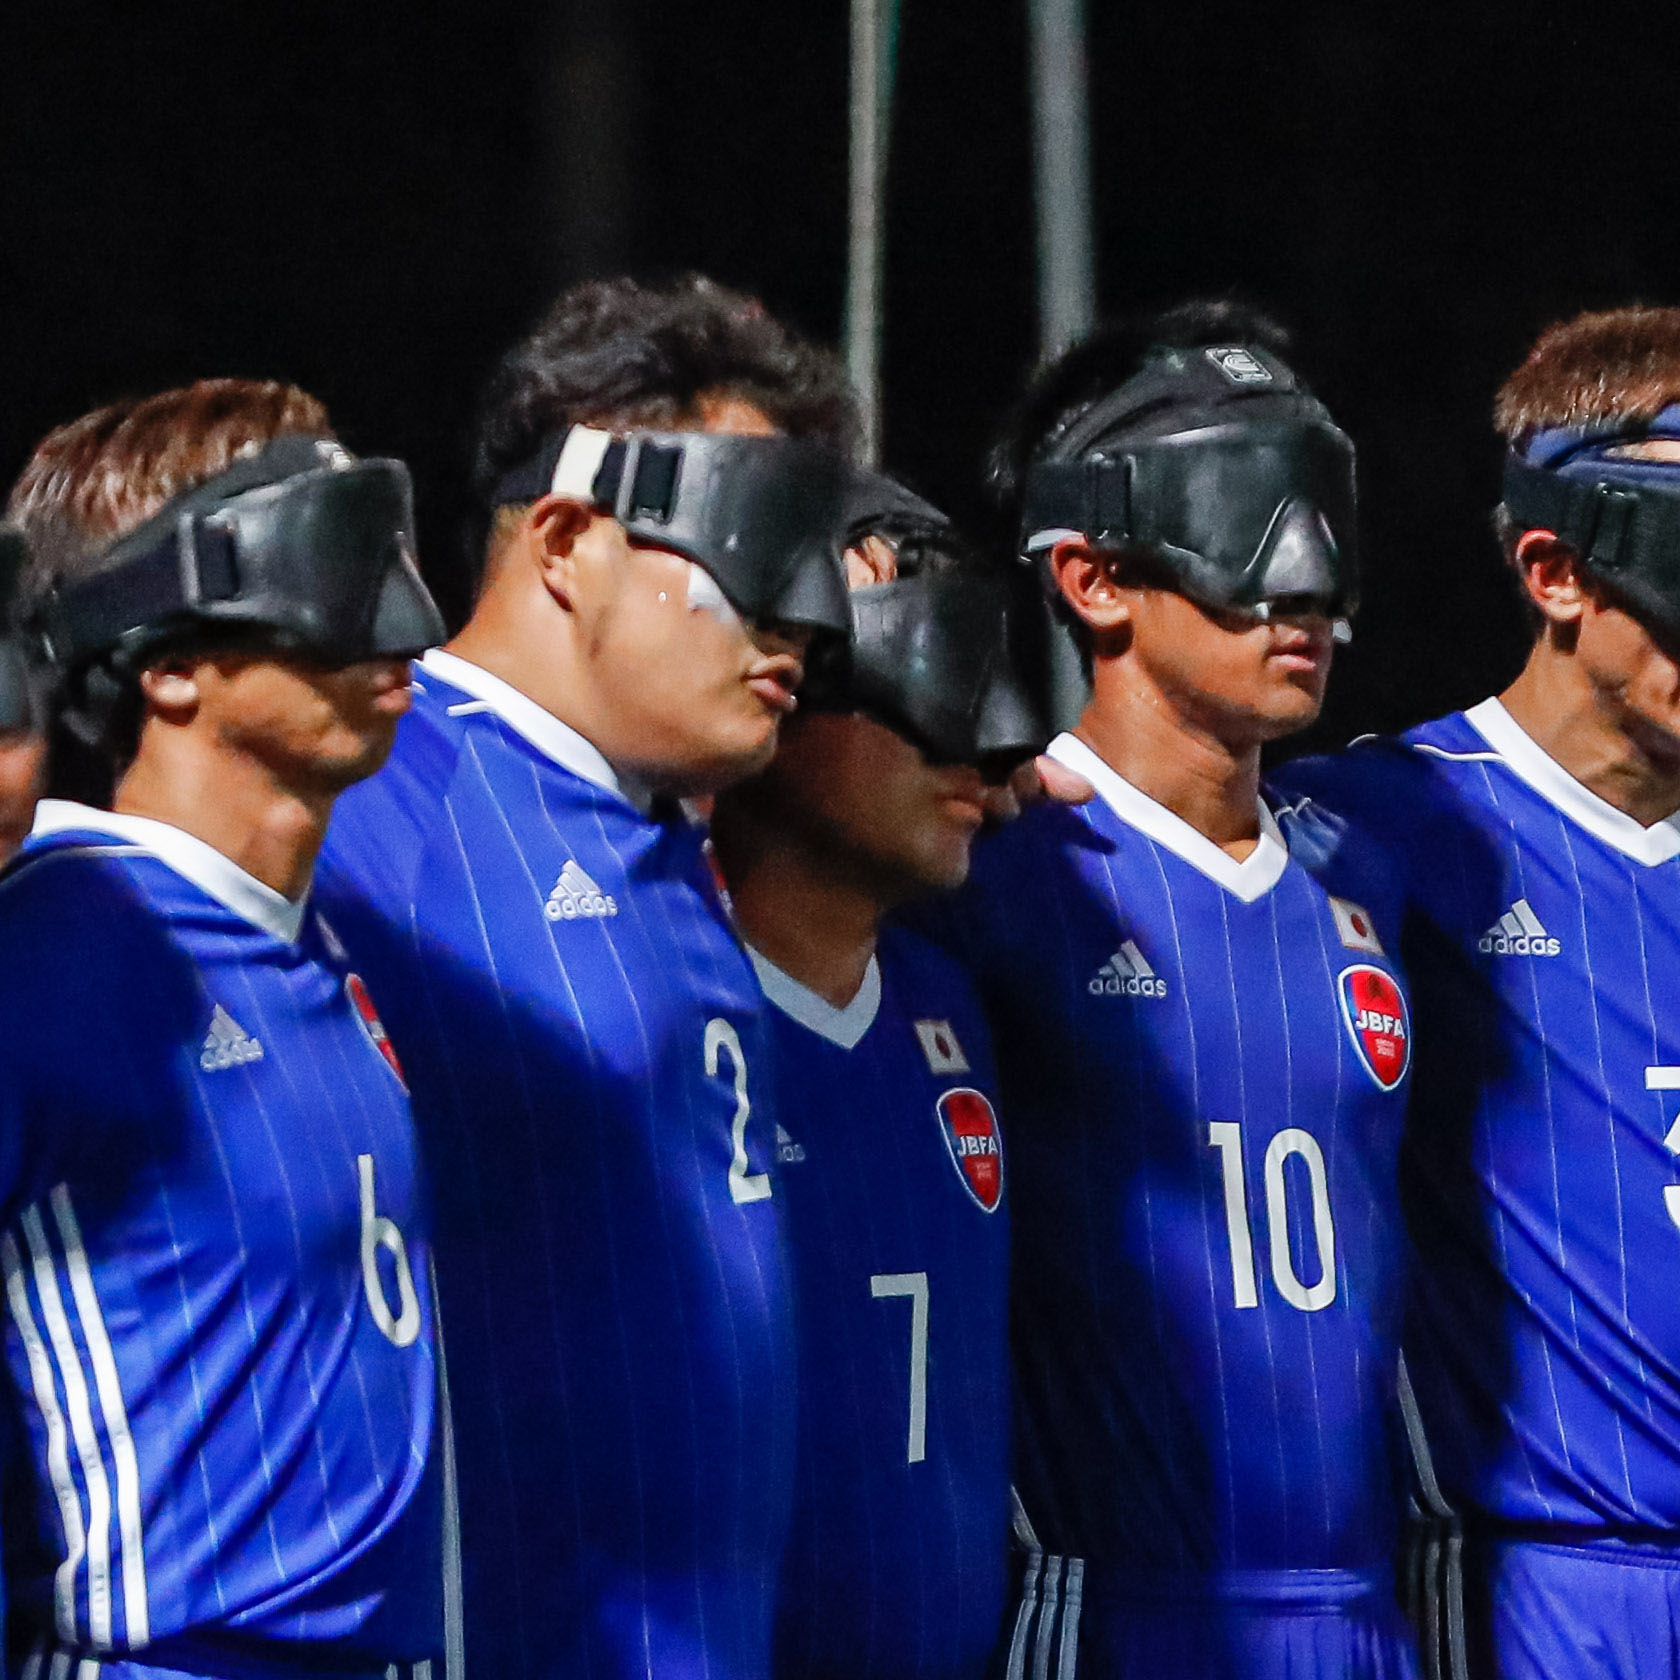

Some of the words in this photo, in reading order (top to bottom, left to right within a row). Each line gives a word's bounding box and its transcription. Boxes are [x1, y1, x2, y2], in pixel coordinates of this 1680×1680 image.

[1087, 973, 1167, 998] adidas
[1478, 934, 1561, 957] adidas
[1355, 1009, 1406, 1040] JBFA
[704, 1018, 772, 1204] 2
[957, 1134, 999, 1158] JBFA
[357, 1153, 421, 1347] 6
[1209, 1121, 1336, 1312] 10
[870, 1272, 928, 1463] 7
